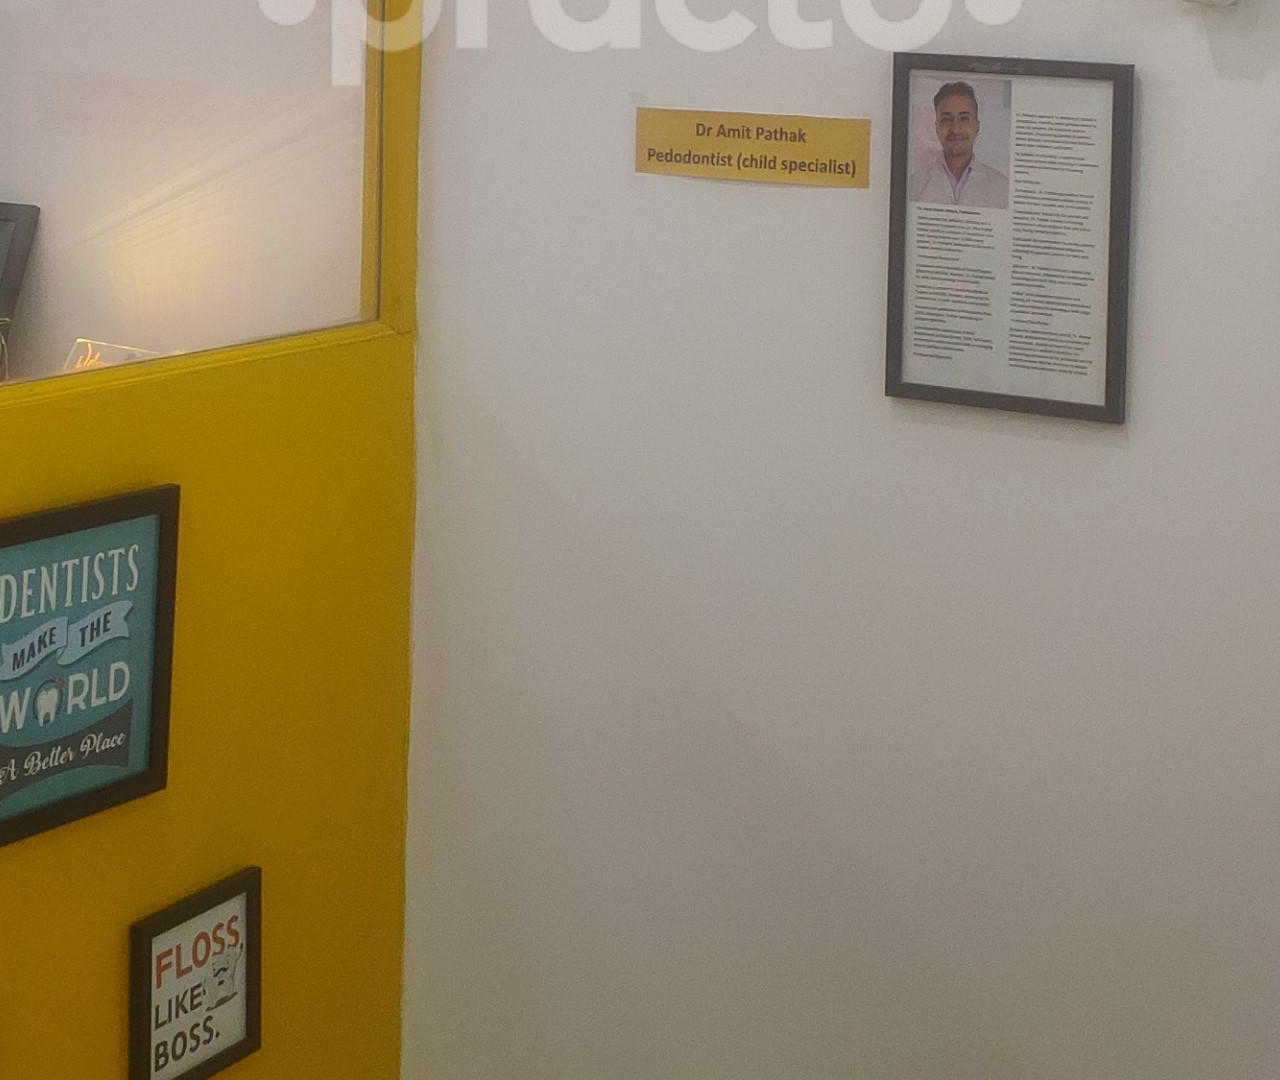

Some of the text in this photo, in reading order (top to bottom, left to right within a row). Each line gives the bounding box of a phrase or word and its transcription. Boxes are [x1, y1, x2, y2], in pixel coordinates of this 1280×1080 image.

[696, 123, 807, 143] Dr Amit Pathak
[648, 148, 856, 178] Pedodontist (child specialist)
[11, 611, 112, 671] MAKE THE
[24, 746, 74, 776] Better
[80, 732, 126, 761] Place
[155, 914, 240, 989] FLOSS
[154, 982, 202, 1030] LIKE
[154, 1015, 220, 1072] BOSS.
